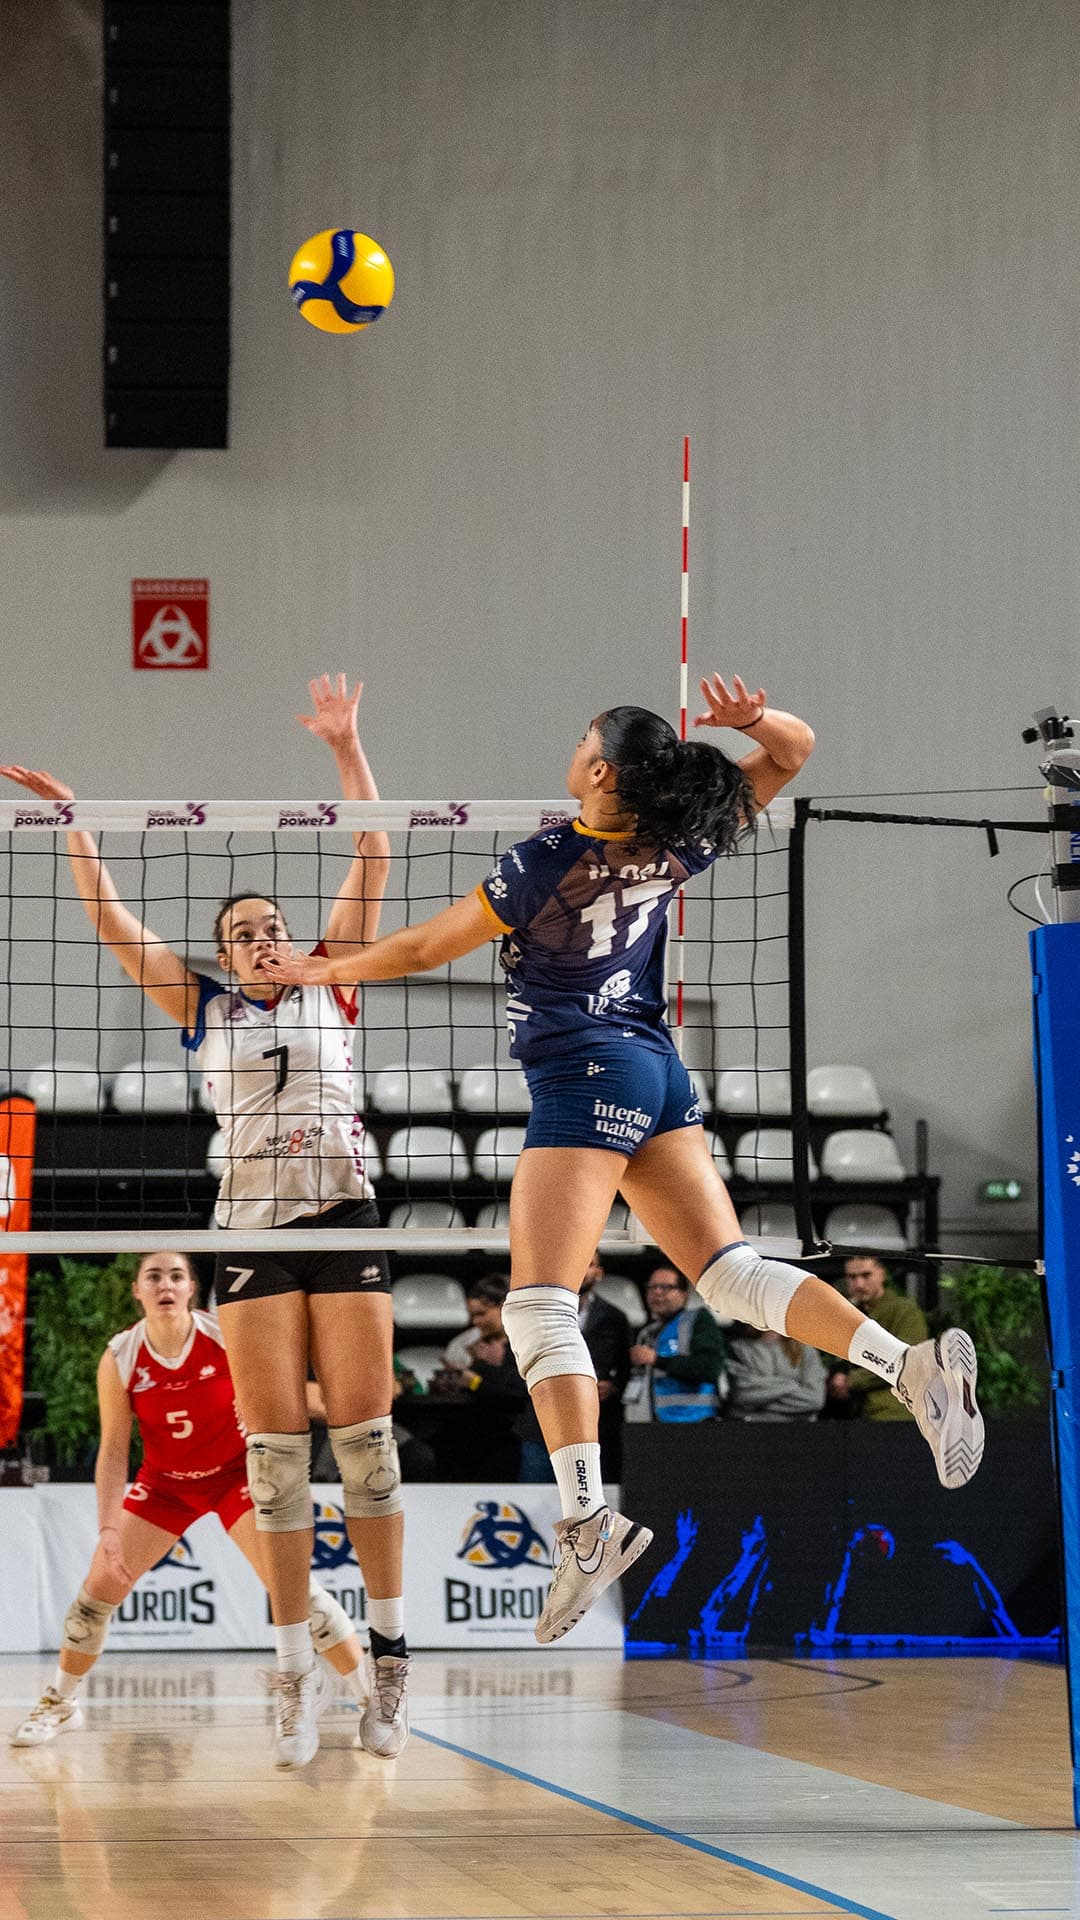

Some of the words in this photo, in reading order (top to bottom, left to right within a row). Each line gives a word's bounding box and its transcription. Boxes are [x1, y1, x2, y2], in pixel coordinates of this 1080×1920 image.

[580, 878, 675, 960] 17
[263, 1045, 288, 1097] 7
[593, 1099, 653, 1129] interim
[225, 1266, 255, 1293] 7
[166, 1410, 193, 1439] 5
[127, 1482, 152, 1501] 5
[576, 1459, 588, 1493] CRAFT
[111, 1580, 215, 1625] URDIS
[445, 1577, 555, 1624] BURDI
